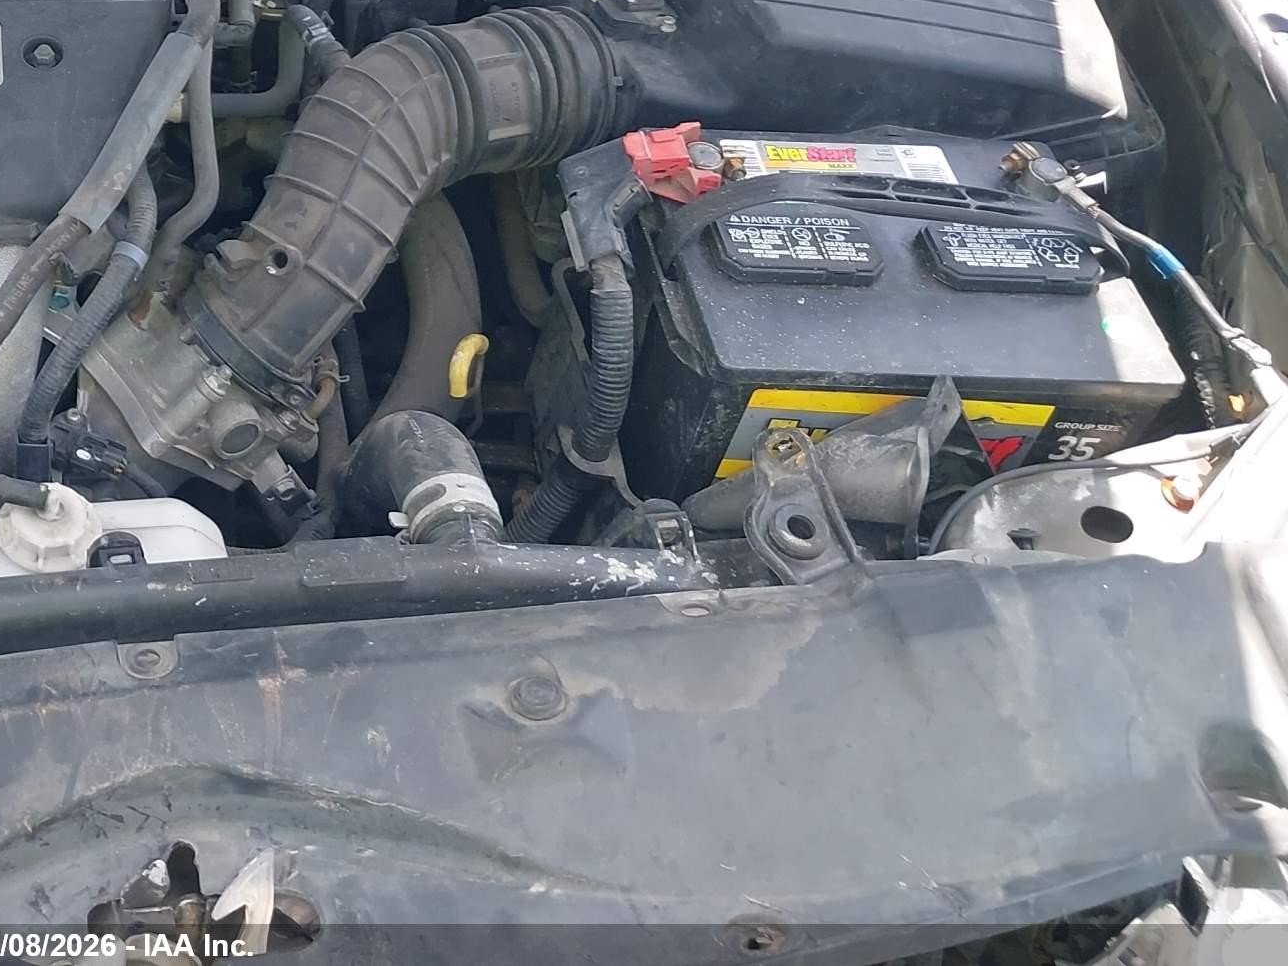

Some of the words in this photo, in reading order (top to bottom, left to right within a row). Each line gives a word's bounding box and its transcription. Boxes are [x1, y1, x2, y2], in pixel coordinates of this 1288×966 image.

[765, 144, 856, 163] EverStart
[741, 215, 792, 224] DANGER
[803, 217, 850, 226] POISON
[1055, 420, 1096, 431] GROUP
[1048, 436, 1102, 462] 35
